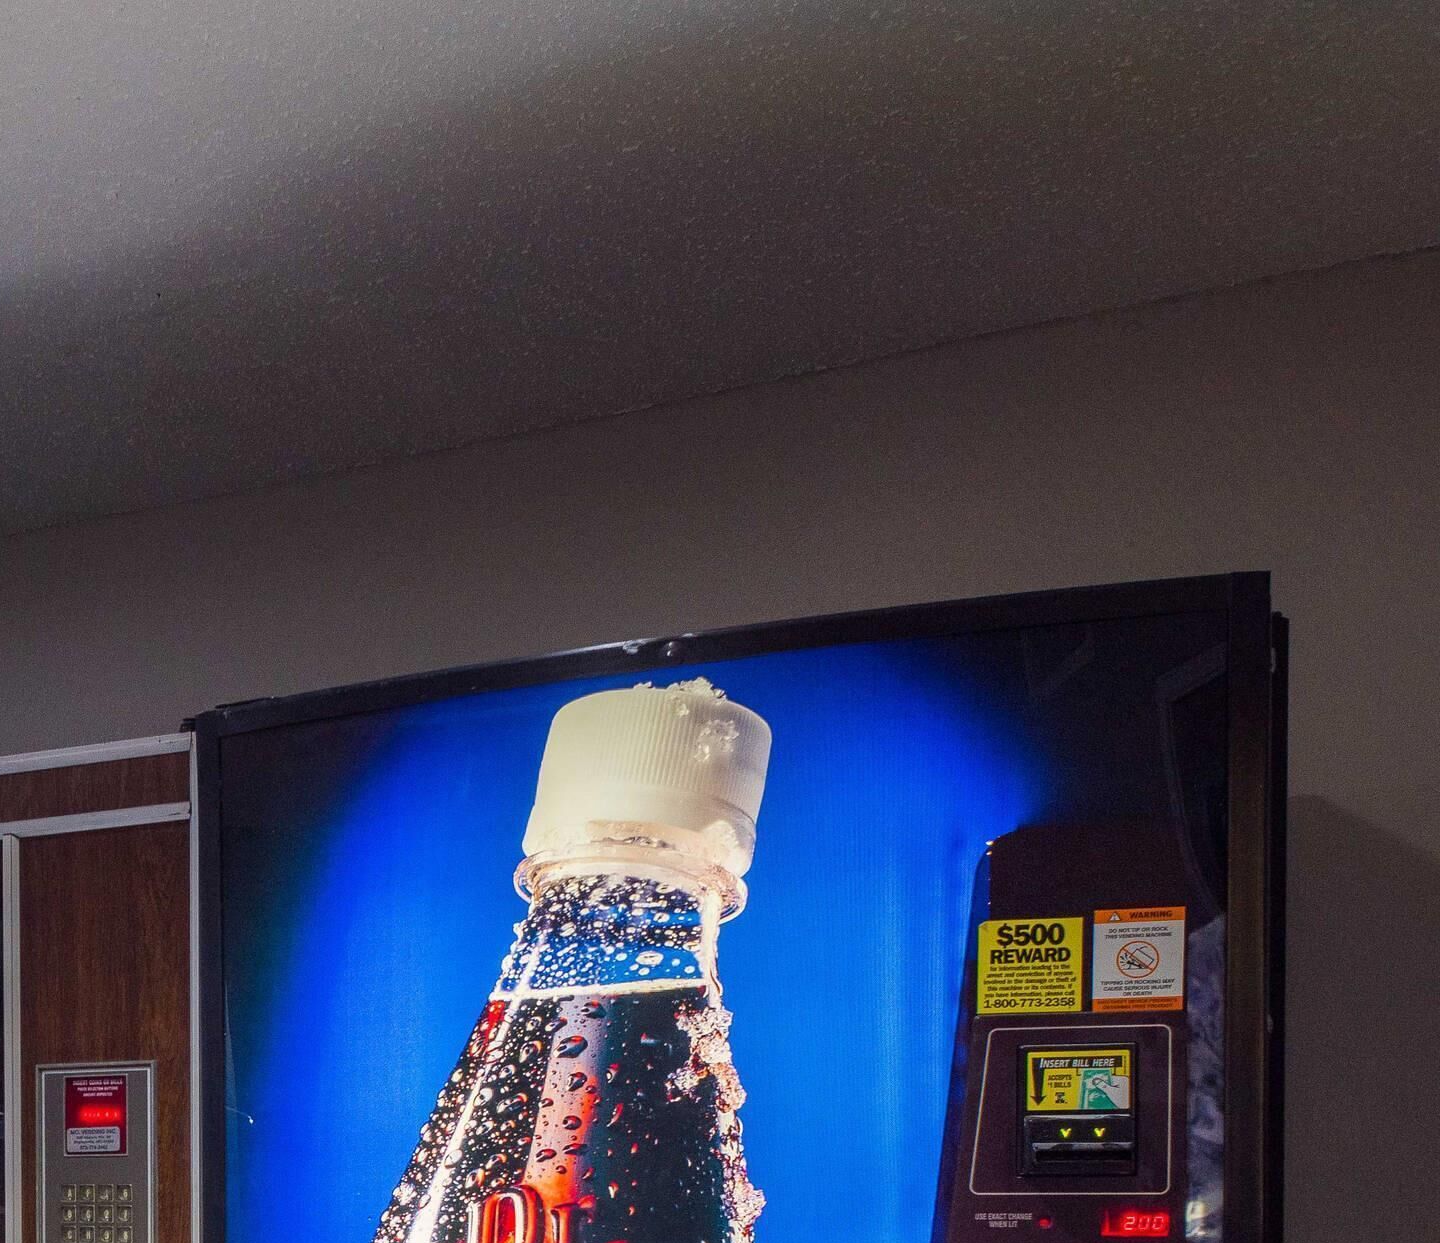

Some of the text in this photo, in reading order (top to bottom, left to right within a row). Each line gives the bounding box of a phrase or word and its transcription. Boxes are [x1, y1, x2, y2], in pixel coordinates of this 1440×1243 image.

[1129, 910, 1173, 919] WARNING
[996, 922, 1065, 948] $500
[990, 947, 1071, 964] REWARD
[983, 997, 1075, 1008] 1-800-773-2358
[1040, 1057, 1071, 1068] INSERT
[1072, 1058, 1089, 1067] BILL
[1092, 1057, 1115, 1067] HERE
[975, 1212, 1032, 1220] USE EXACT CHANGE
[989, 1220, 1018, 1228] WHEN LIT
